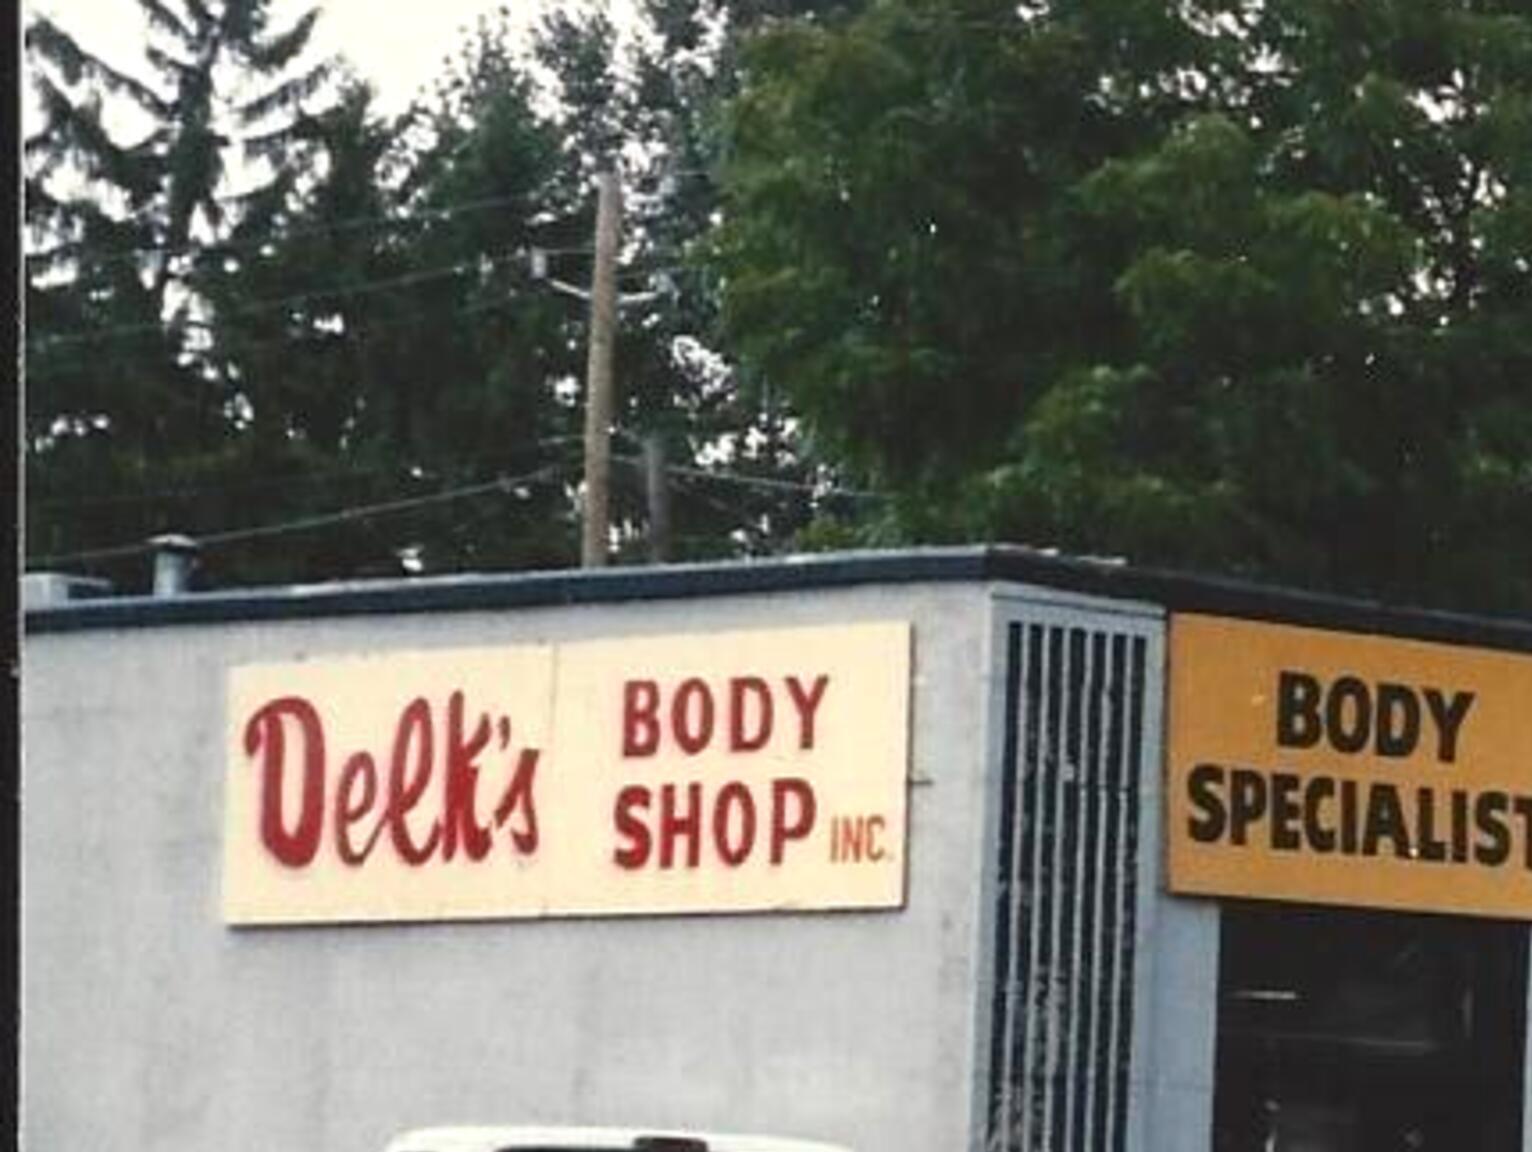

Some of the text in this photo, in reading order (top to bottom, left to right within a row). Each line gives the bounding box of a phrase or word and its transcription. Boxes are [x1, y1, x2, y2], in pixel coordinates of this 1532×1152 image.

[620, 674, 830, 759] BODY
[1276, 670, 1476, 764] BODY
[244, 689, 541, 869] Delk's
[612, 777, 817, 871] SHOP
